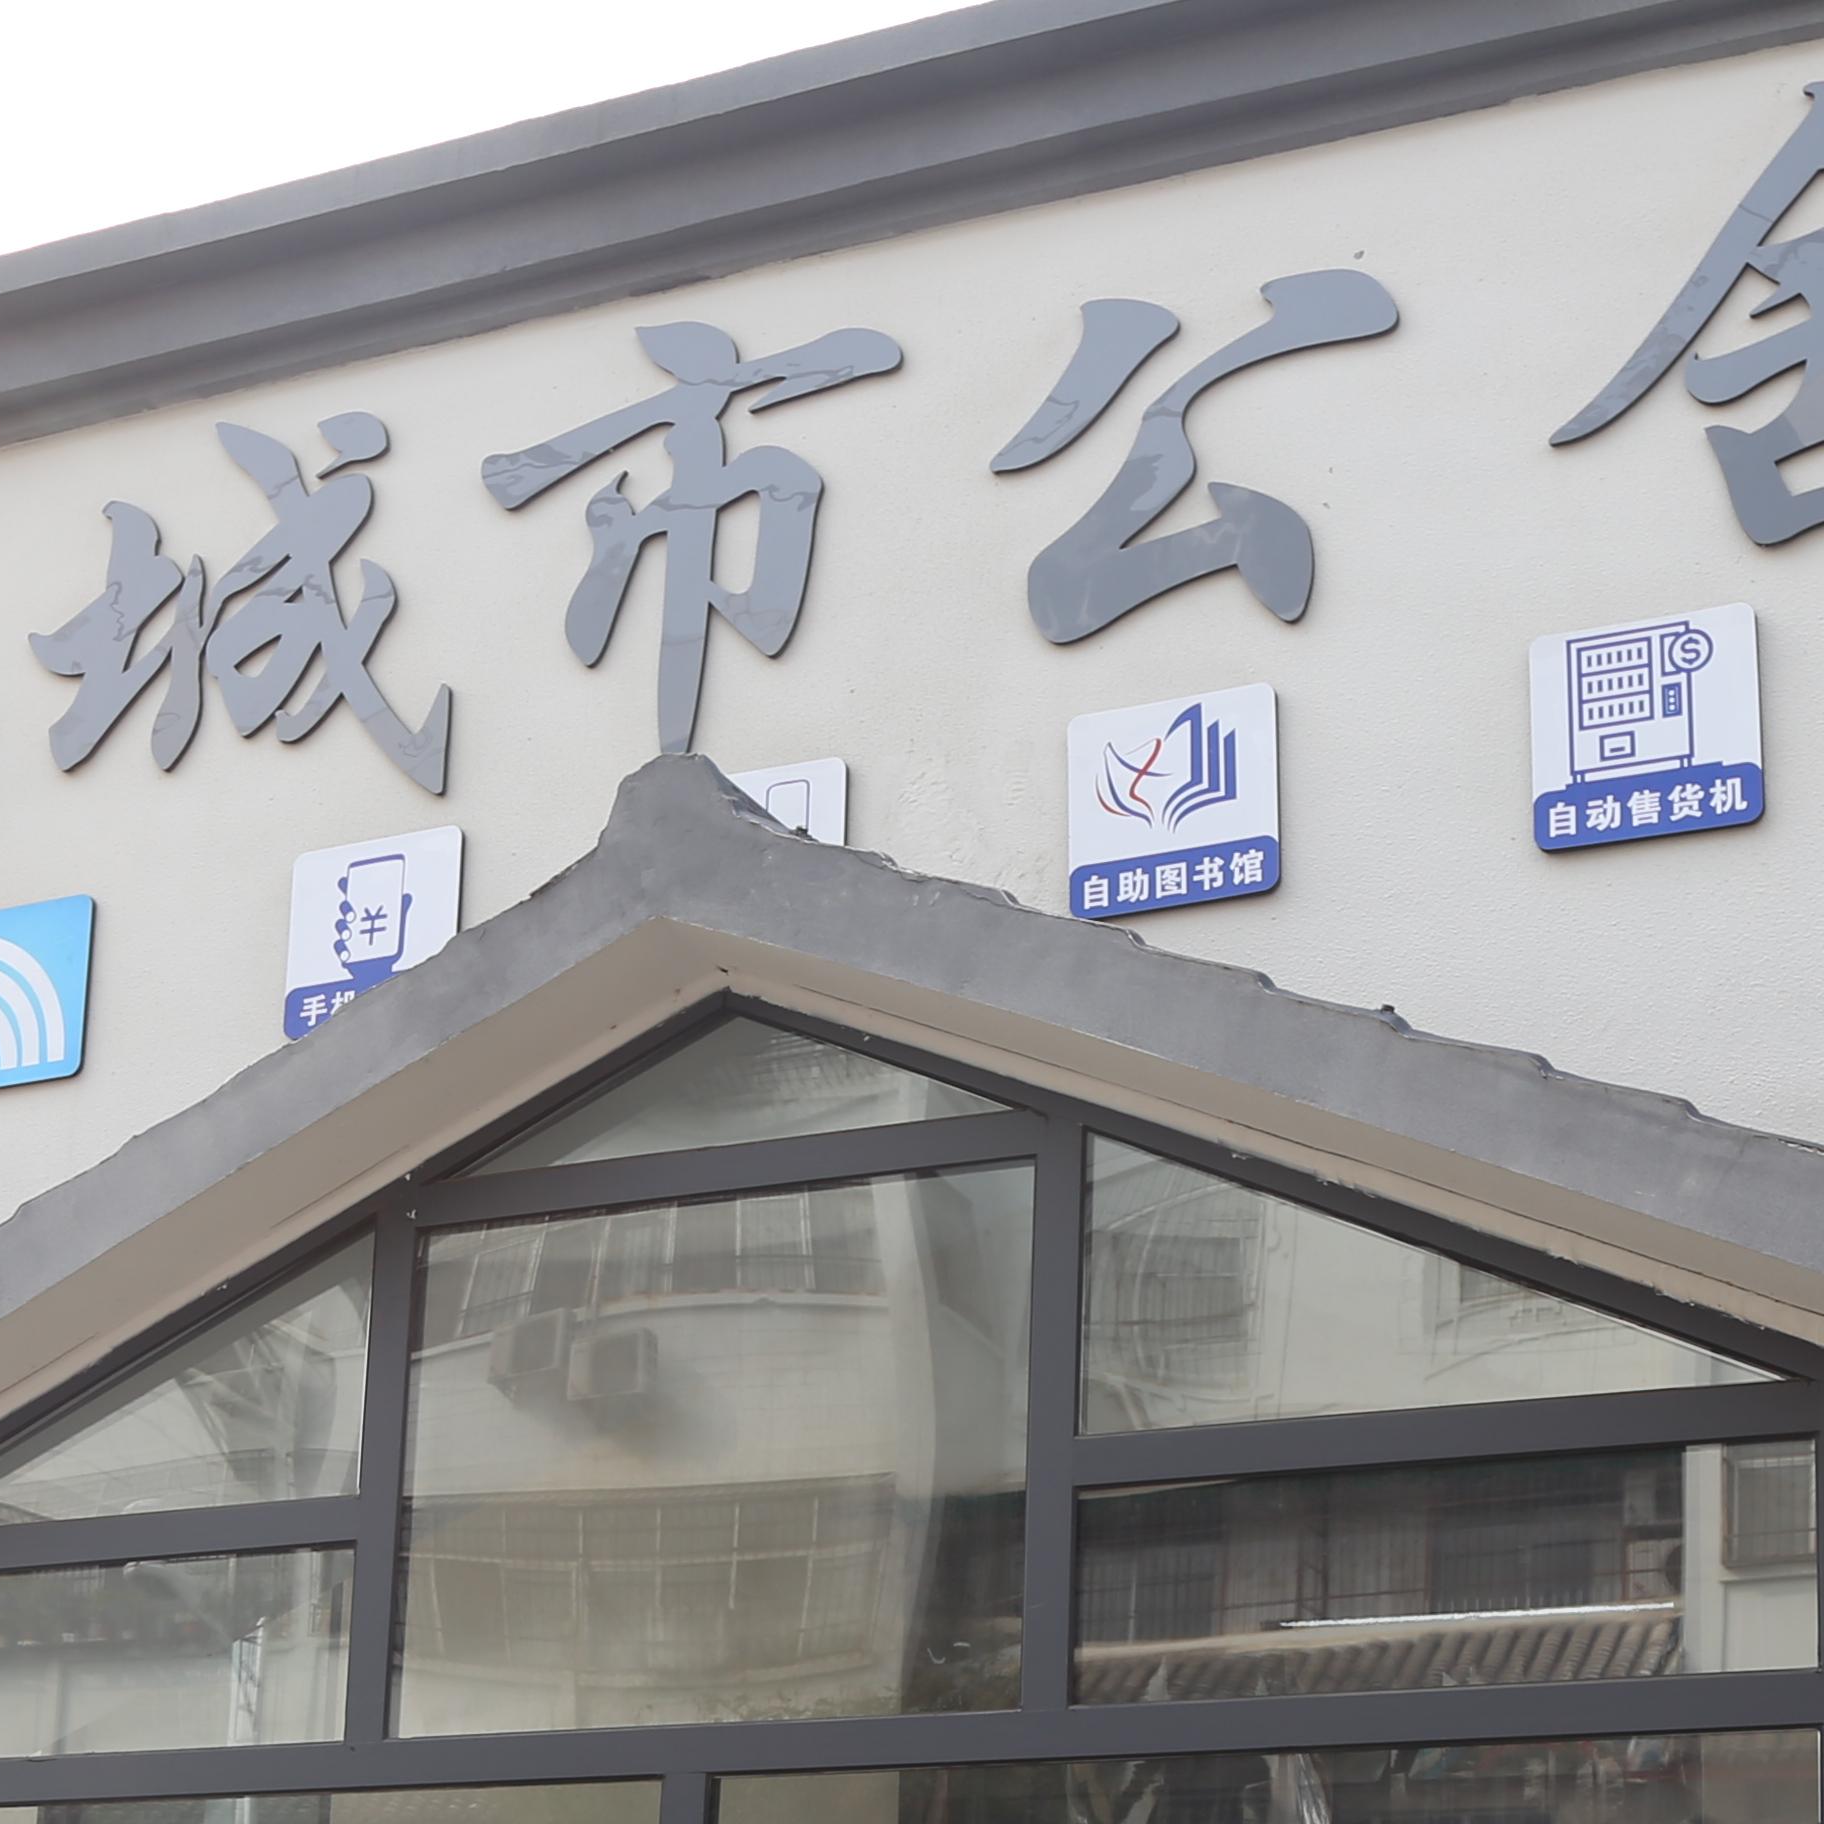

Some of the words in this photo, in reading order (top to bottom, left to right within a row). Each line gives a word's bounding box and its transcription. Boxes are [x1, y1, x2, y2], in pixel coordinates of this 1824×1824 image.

[1547, 776, 1750, 839] 自动售货机
[1082, 848, 1263, 910] 自助图书馆
